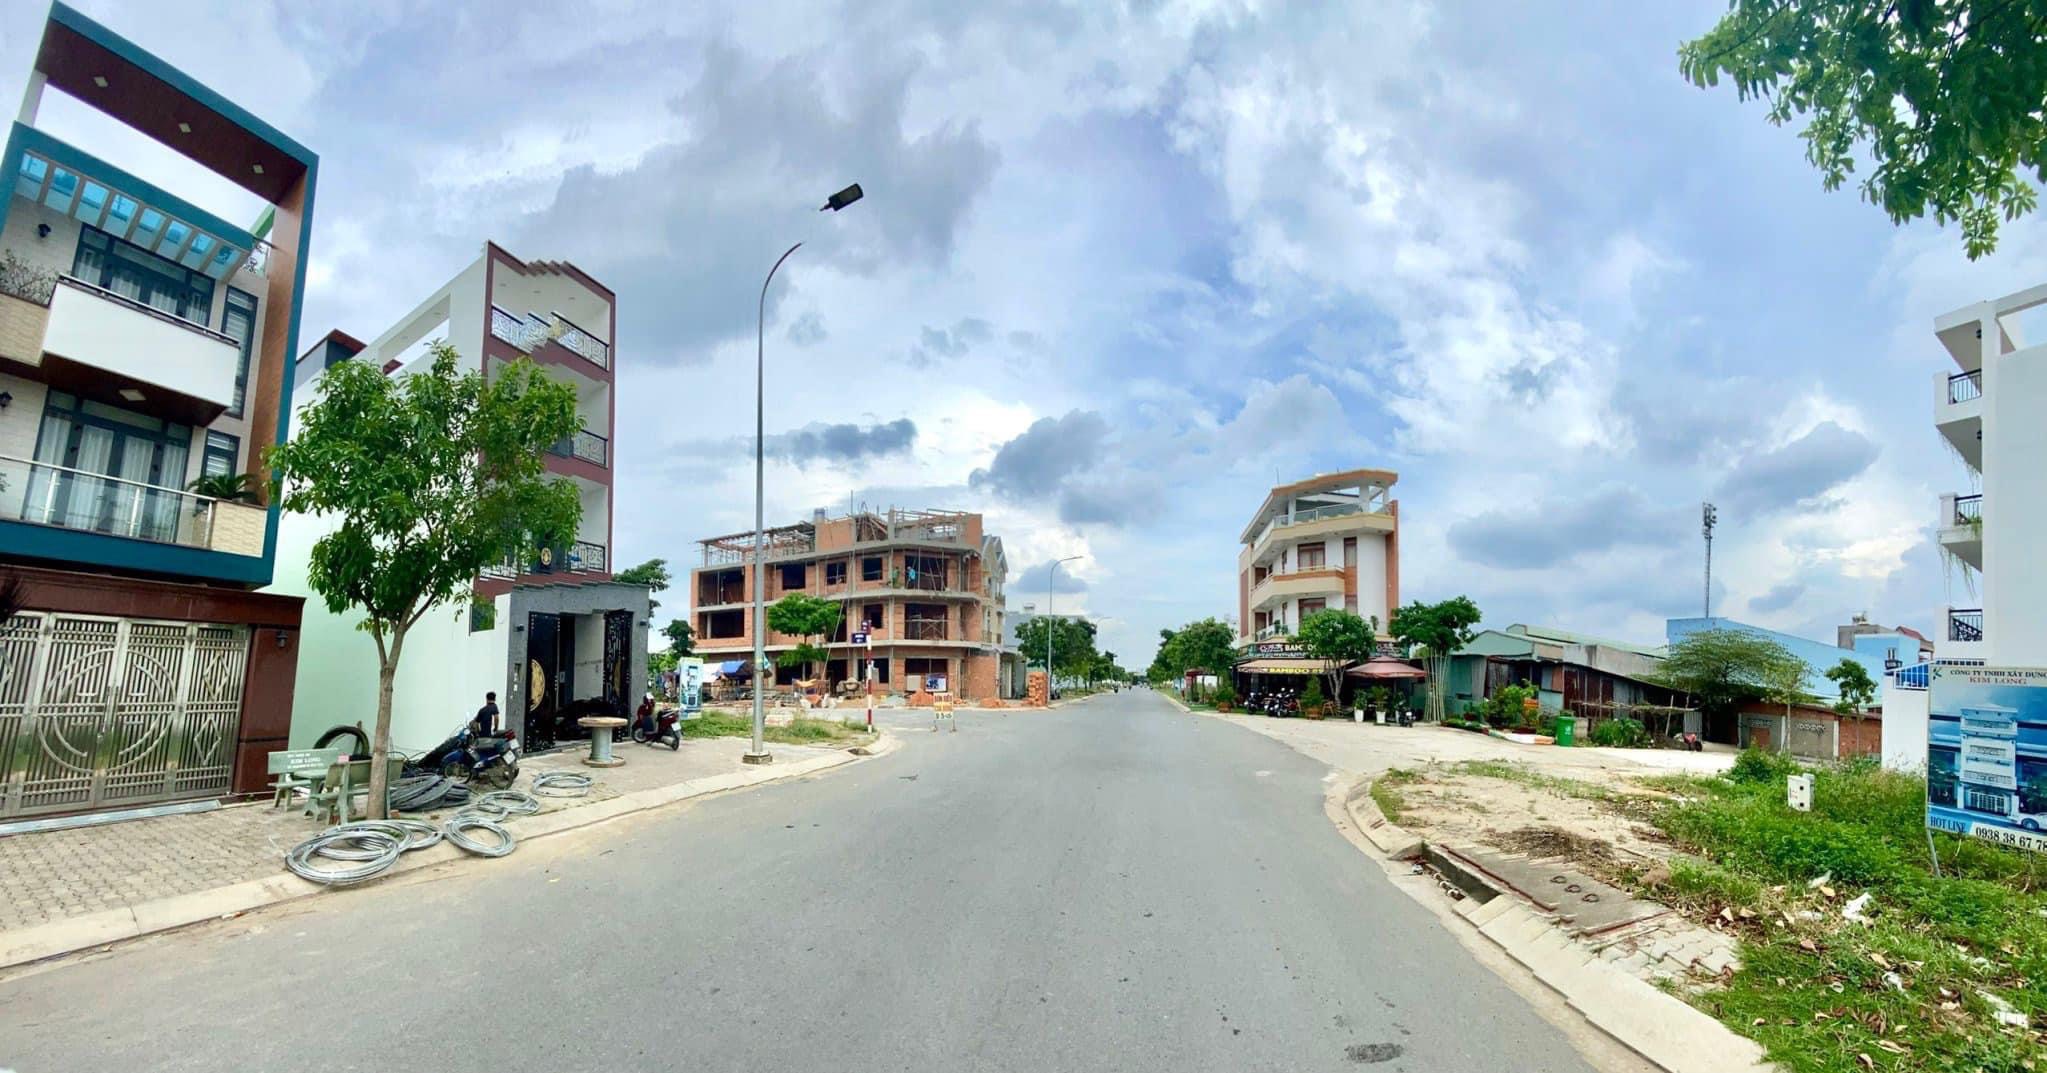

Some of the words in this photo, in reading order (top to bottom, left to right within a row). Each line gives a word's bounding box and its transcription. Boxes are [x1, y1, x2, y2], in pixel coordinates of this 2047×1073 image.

[1975, 827, 2000, 841] 0938
[2003, 832, 2016, 845] 38
[2019, 836, 2032, 848] 67
